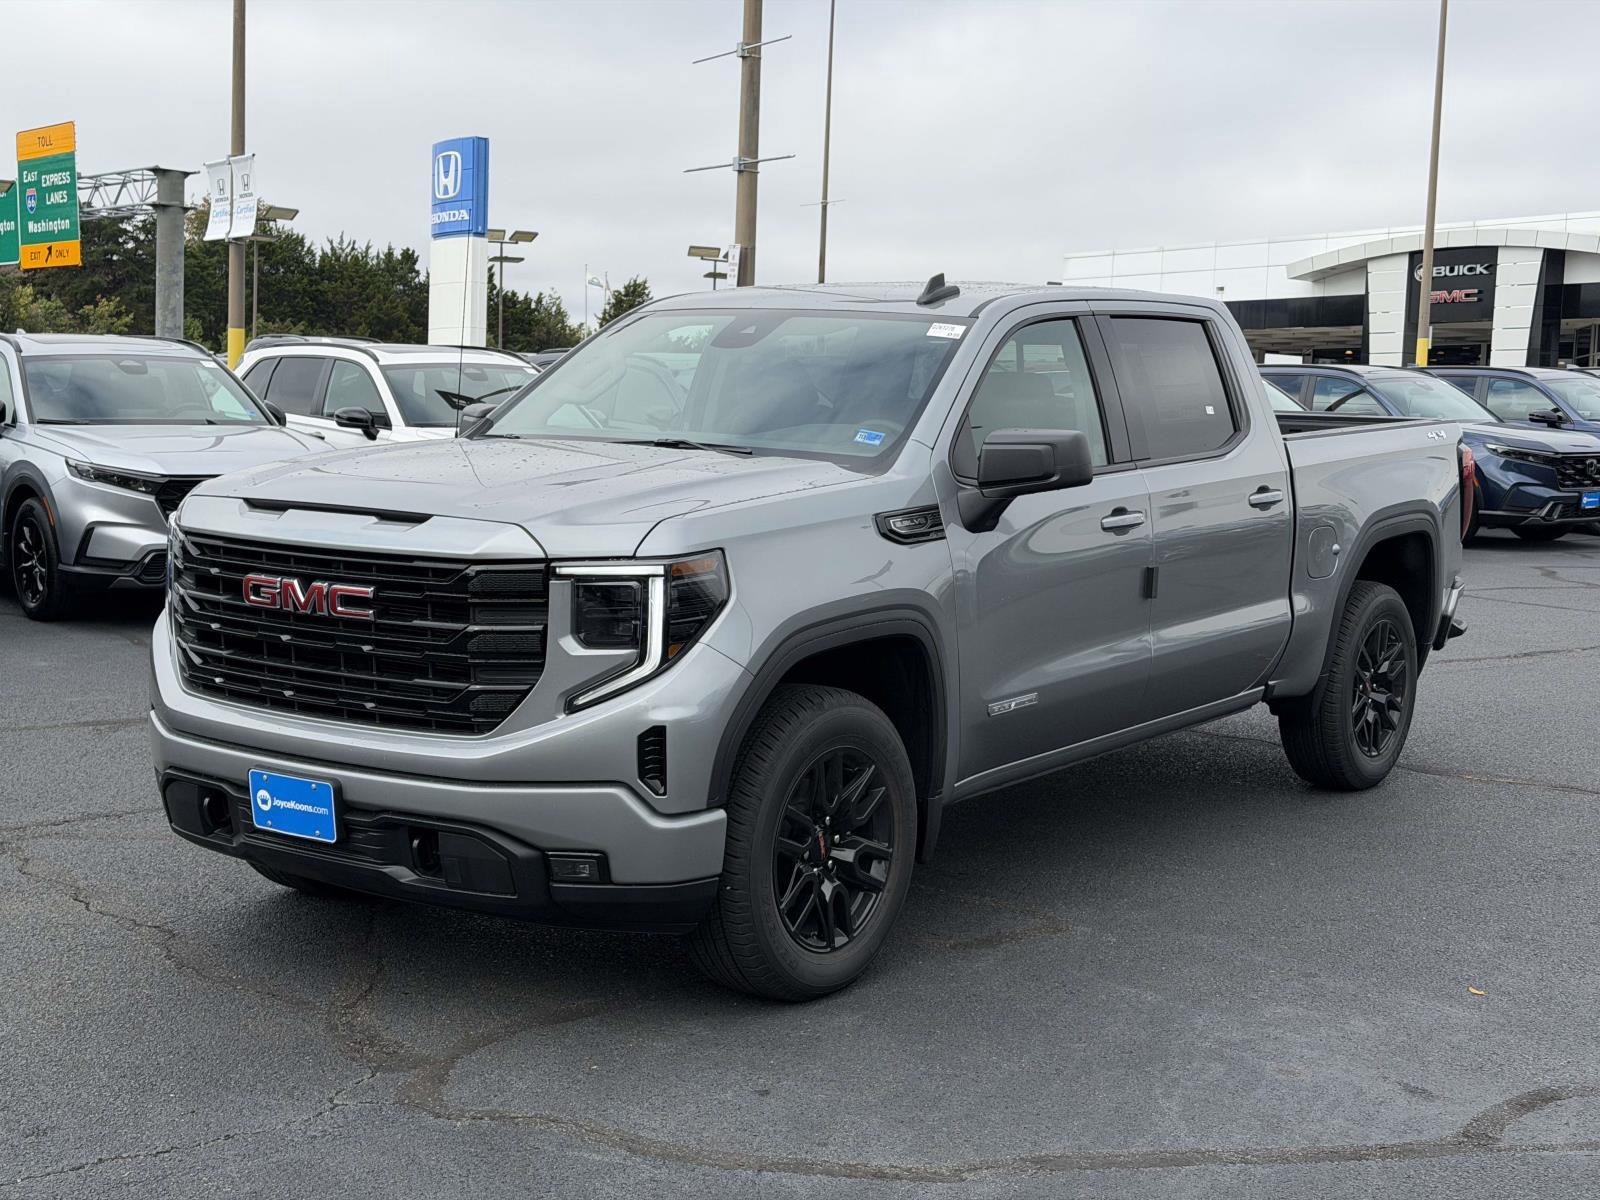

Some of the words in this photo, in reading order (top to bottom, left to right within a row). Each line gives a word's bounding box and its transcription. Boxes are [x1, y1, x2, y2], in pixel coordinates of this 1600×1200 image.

[37, 135, 53, 148] TOLL
[41, 171, 71, 188] EXPRESS
[27, 195, 36, 207] 66
[45, 191, 68, 205] LANES
[28, 217, 70, 234] Washington
[30, 251, 41, 261] EXIT
[55, 248, 70, 259] ONLY
[1432, 263, 1491, 277] BUICK
[243, 574, 375, 621] GMC
[273, 797, 329, 815] JoyceKoons.com
